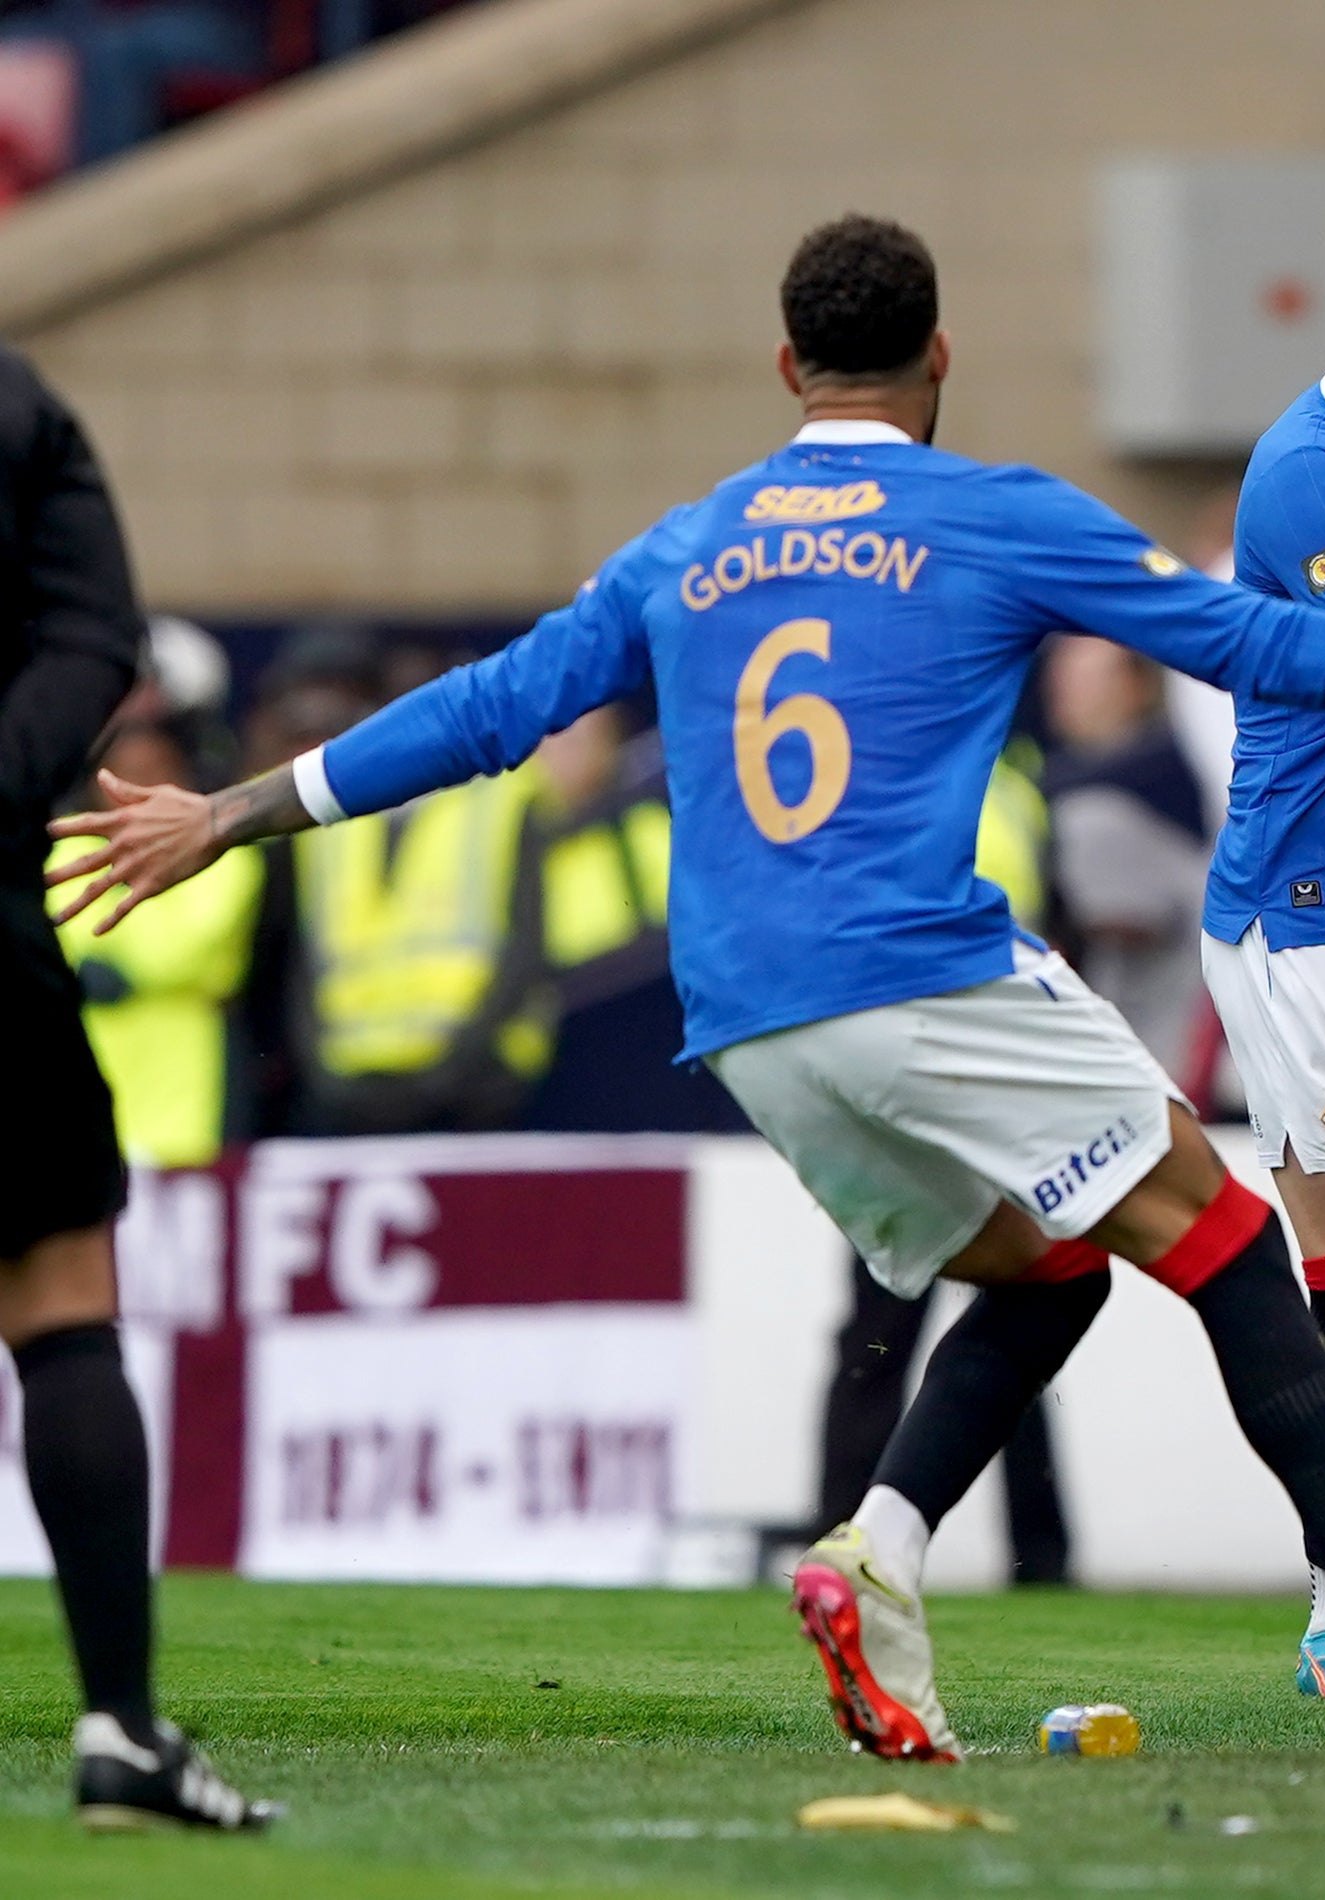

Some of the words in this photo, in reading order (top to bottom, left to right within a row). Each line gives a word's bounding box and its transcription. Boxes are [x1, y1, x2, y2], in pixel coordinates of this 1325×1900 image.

[744, 480, 887, 521] SEKO
[680, 528, 930, 612] GOLDSON
[733, 617, 851, 844] 6
